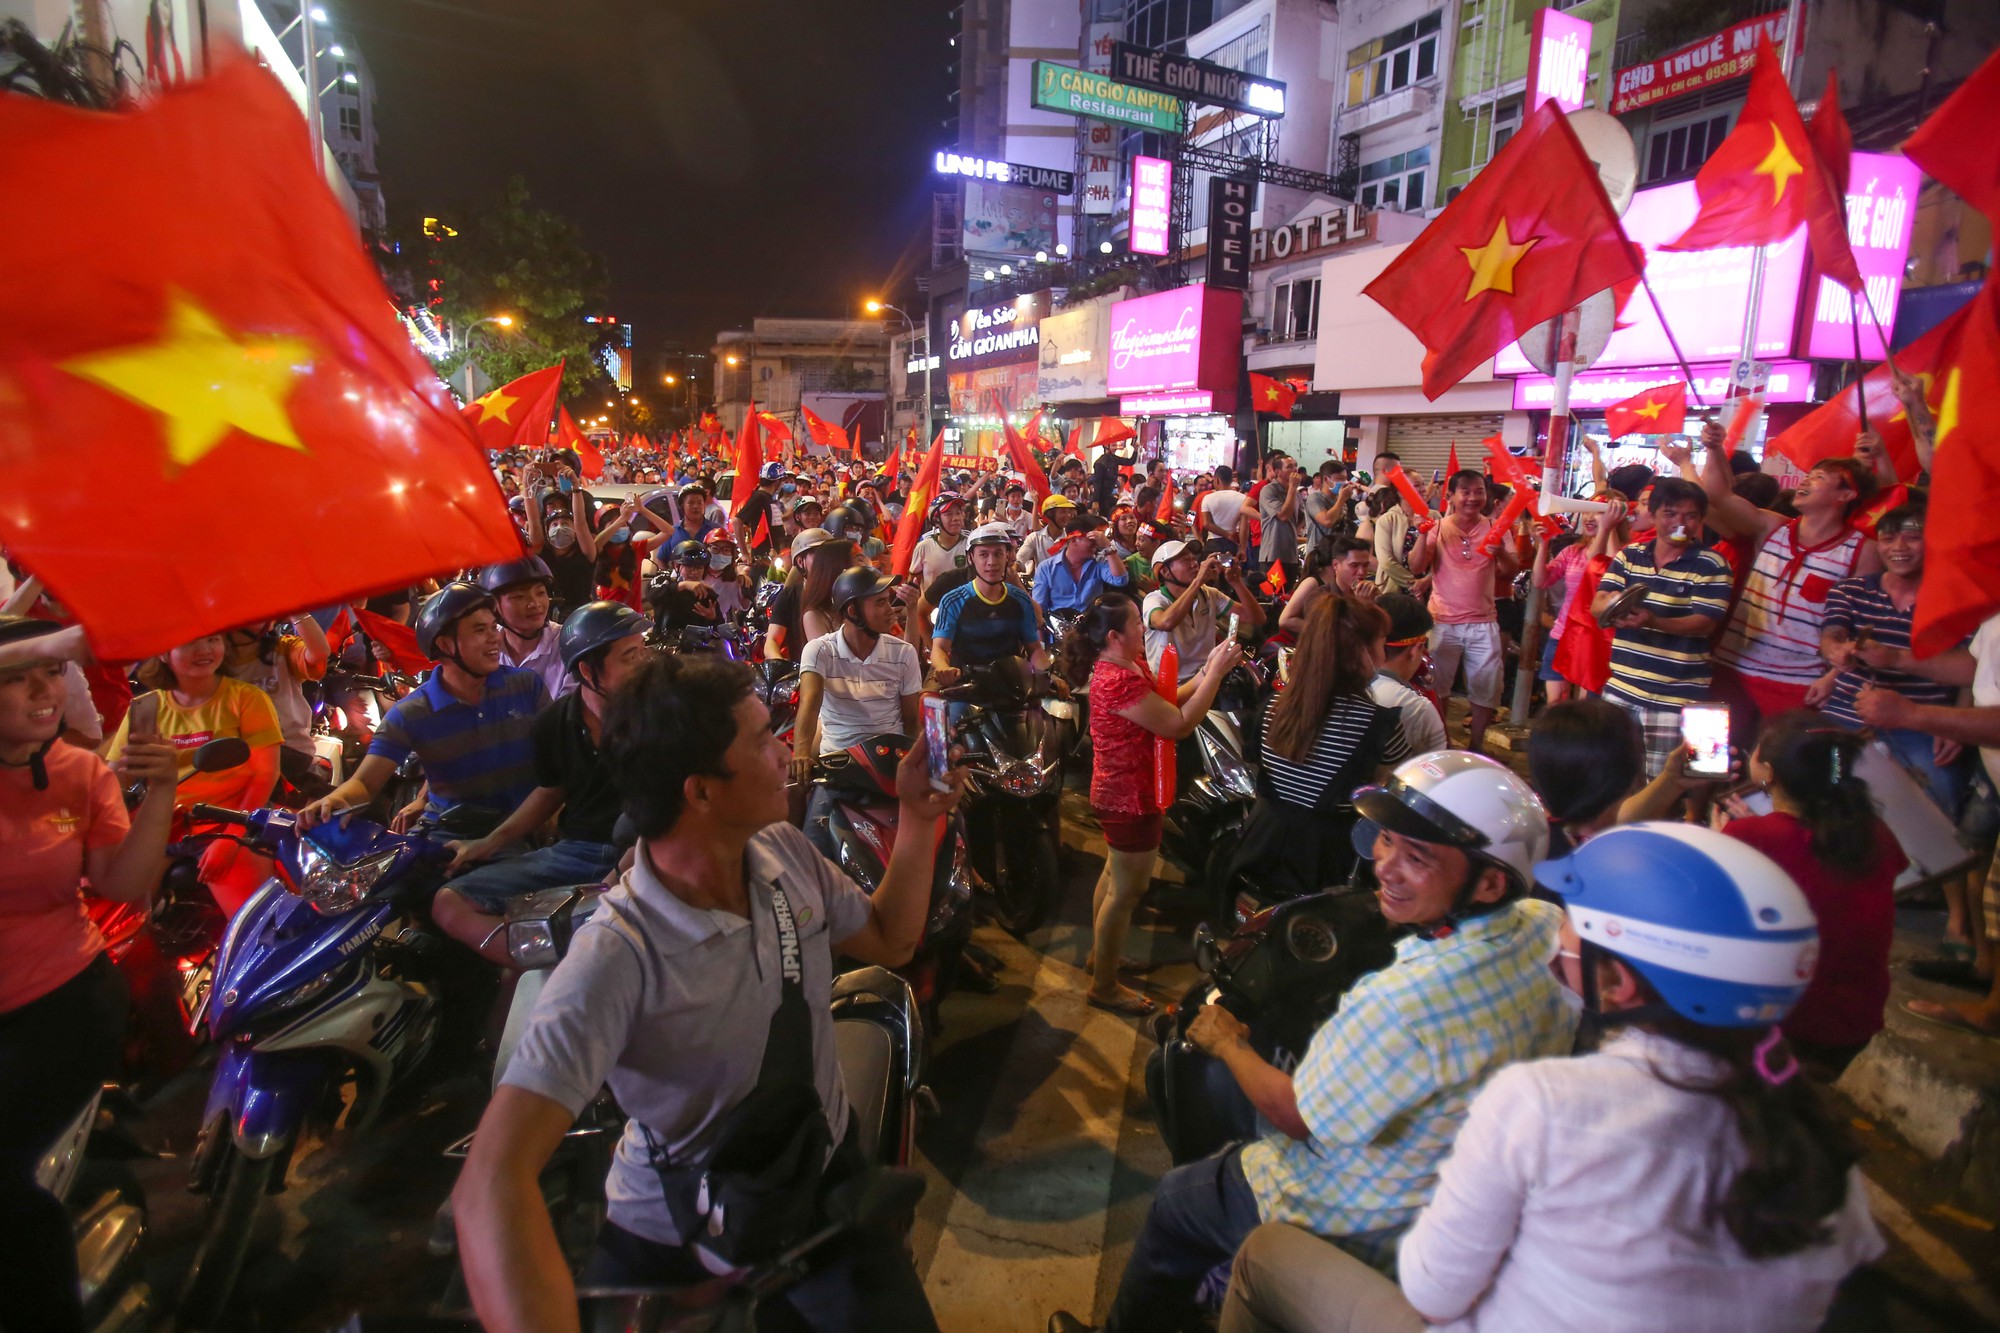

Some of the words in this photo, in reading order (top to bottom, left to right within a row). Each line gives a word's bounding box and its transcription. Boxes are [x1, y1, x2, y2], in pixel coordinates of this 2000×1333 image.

[1123, 51, 1164, 83] THẾ
[1164, 60, 1200, 93] GIỚI
[1203, 71, 1249, 101] NƯỚC
[1538, 31, 1587, 105] NƯỚC
[1705, 58, 1737, 82] 0938
[1060, 70, 1095, 96] CẦN
[1096, 82, 1125, 101] GIỜ
[1126, 86, 1180, 115] ANPHA
[1069, 93, 1155, 124] Restaurant
[985, 160, 1068, 190] PERFUME
[1223, 182, 1246, 273] HOTEL
[1250, 203, 1367, 264] HOTEL
[1869, 185, 1907, 250] GIỚI
[992, 306, 1018, 325] Sào
[949, 336, 972, 360] CẦN
[950, 457, 977, 469] NAM
[337, 922, 381, 956] YAMAHA
[781, 938, 801, 984] JPN
